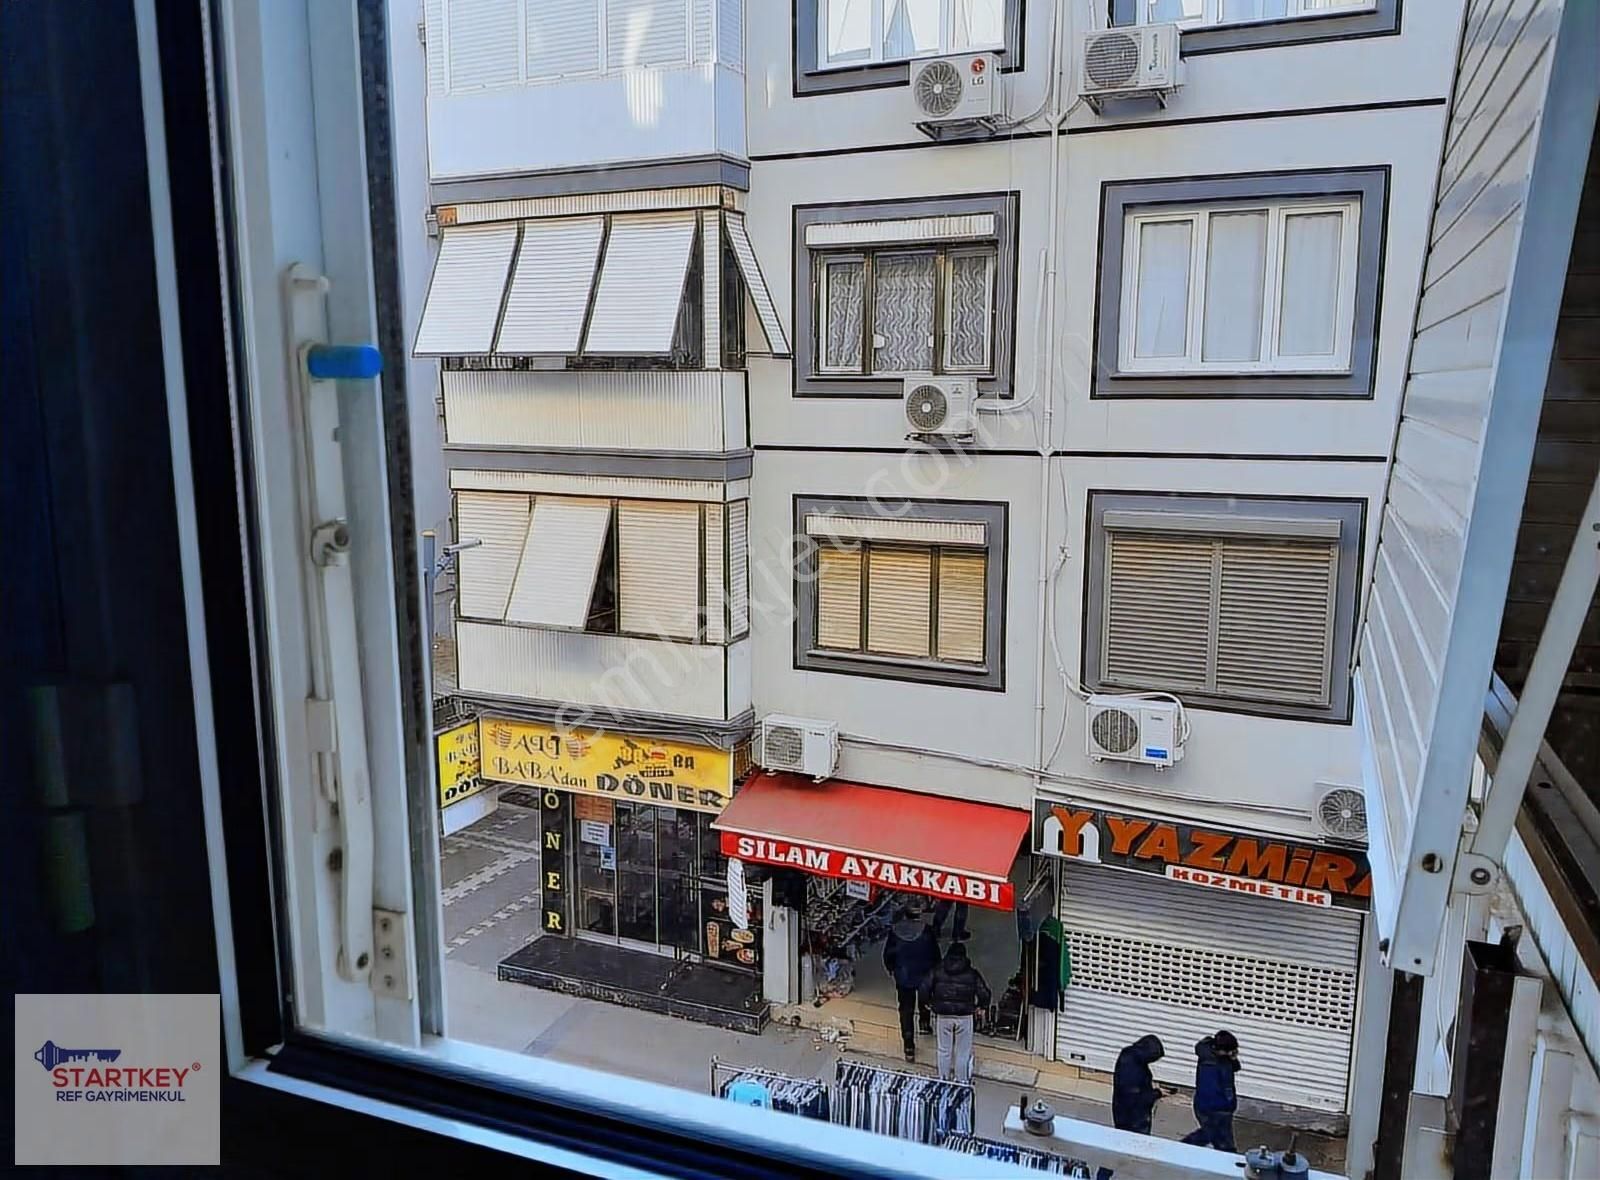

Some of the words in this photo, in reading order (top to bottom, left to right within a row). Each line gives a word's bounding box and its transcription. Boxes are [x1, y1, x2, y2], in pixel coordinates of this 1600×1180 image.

[970, 75, 986, 87] LG
[596, 773, 723, 808] DÖNER
[737, 837, 829, 872] SILAM
[841, 857, 1001, 904] AYAKKABI
